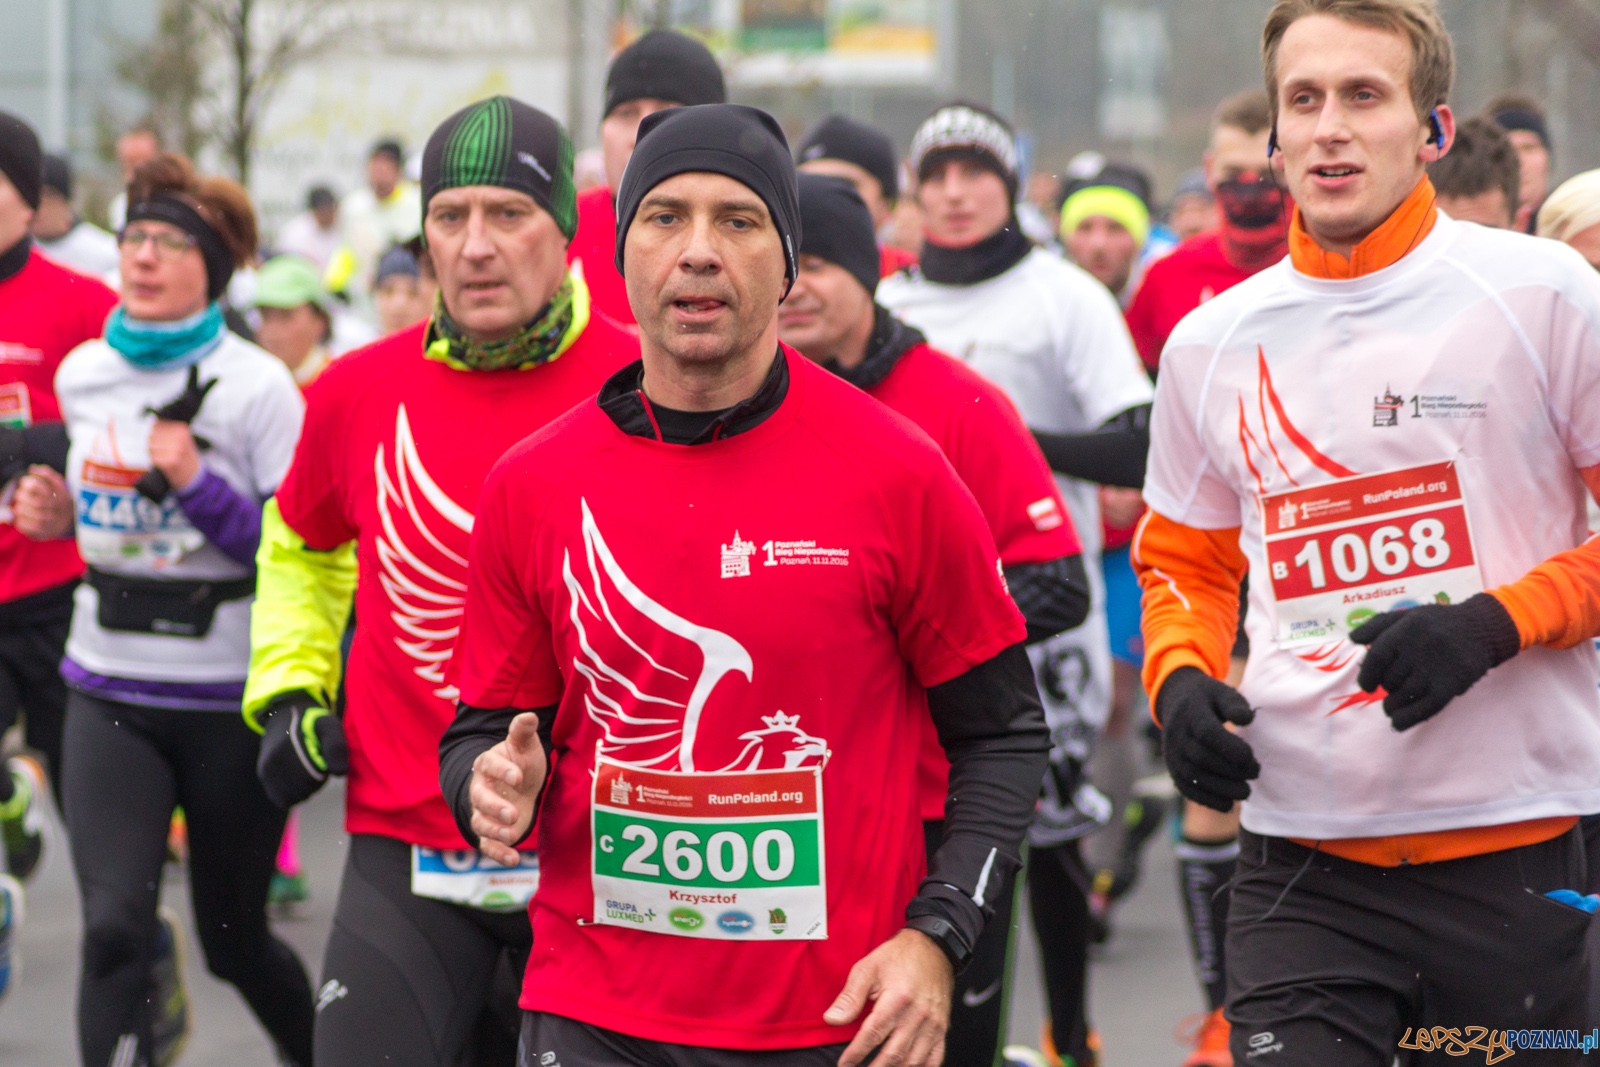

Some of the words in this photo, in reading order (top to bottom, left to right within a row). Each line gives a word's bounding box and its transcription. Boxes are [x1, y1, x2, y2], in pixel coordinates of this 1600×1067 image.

[1410, 395, 1422, 418] 1
[1363, 480, 1448, 505] RunPoland.org
[775, 540, 816, 548] Poznański
[775, 548, 793, 556] Bieg
[794, 547, 849, 557] Niepodległości
[762, 540, 778, 566] 1
[812, 556, 849, 566] 11.11.2016
[1272, 561, 1289, 580] B
[1294, 517, 1451, 589] 1068
[1343, 586, 1407, 604] Arkadiusz
[635, 785, 646, 803] 1
[708, 790, 804, 805] RunPoland.org
[621, 823, 796, 883] 2600
[669, 889, 738, 905] Krzysztof
[606, 899, 638, 913] GRUPA
[606, 909, 645, 924] LUXMED
